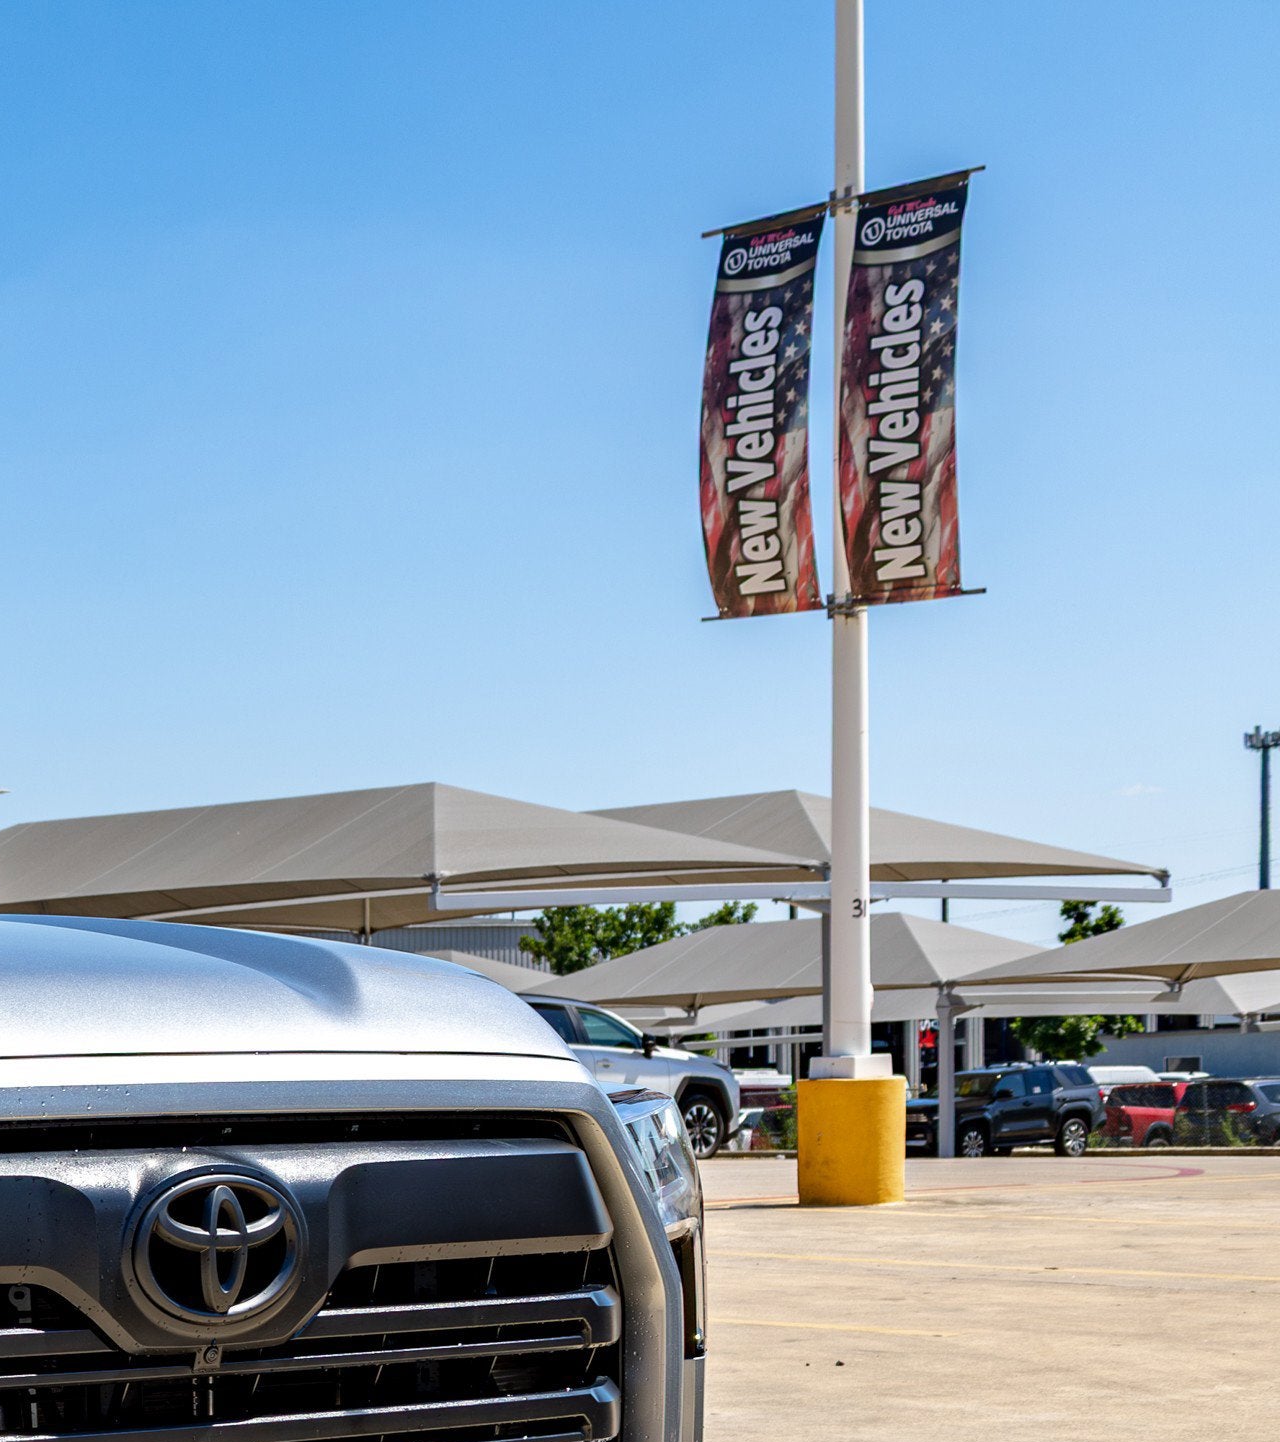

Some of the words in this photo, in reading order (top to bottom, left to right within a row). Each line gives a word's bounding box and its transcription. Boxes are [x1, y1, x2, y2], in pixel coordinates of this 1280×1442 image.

[749, 232, 815, 258] UNIVERSAL
[885, 220, 934, 241] TOYOTA
[887, 201, 959, 228] UNIVERSAL
[747, 251, 792, 270] TOYOTA
[726, 305, 784, 493] Vehicles
[868, 278, 925, 473] Vehicles
[735, 501, 786, 596] New
[873, 480, 926, 583] New
